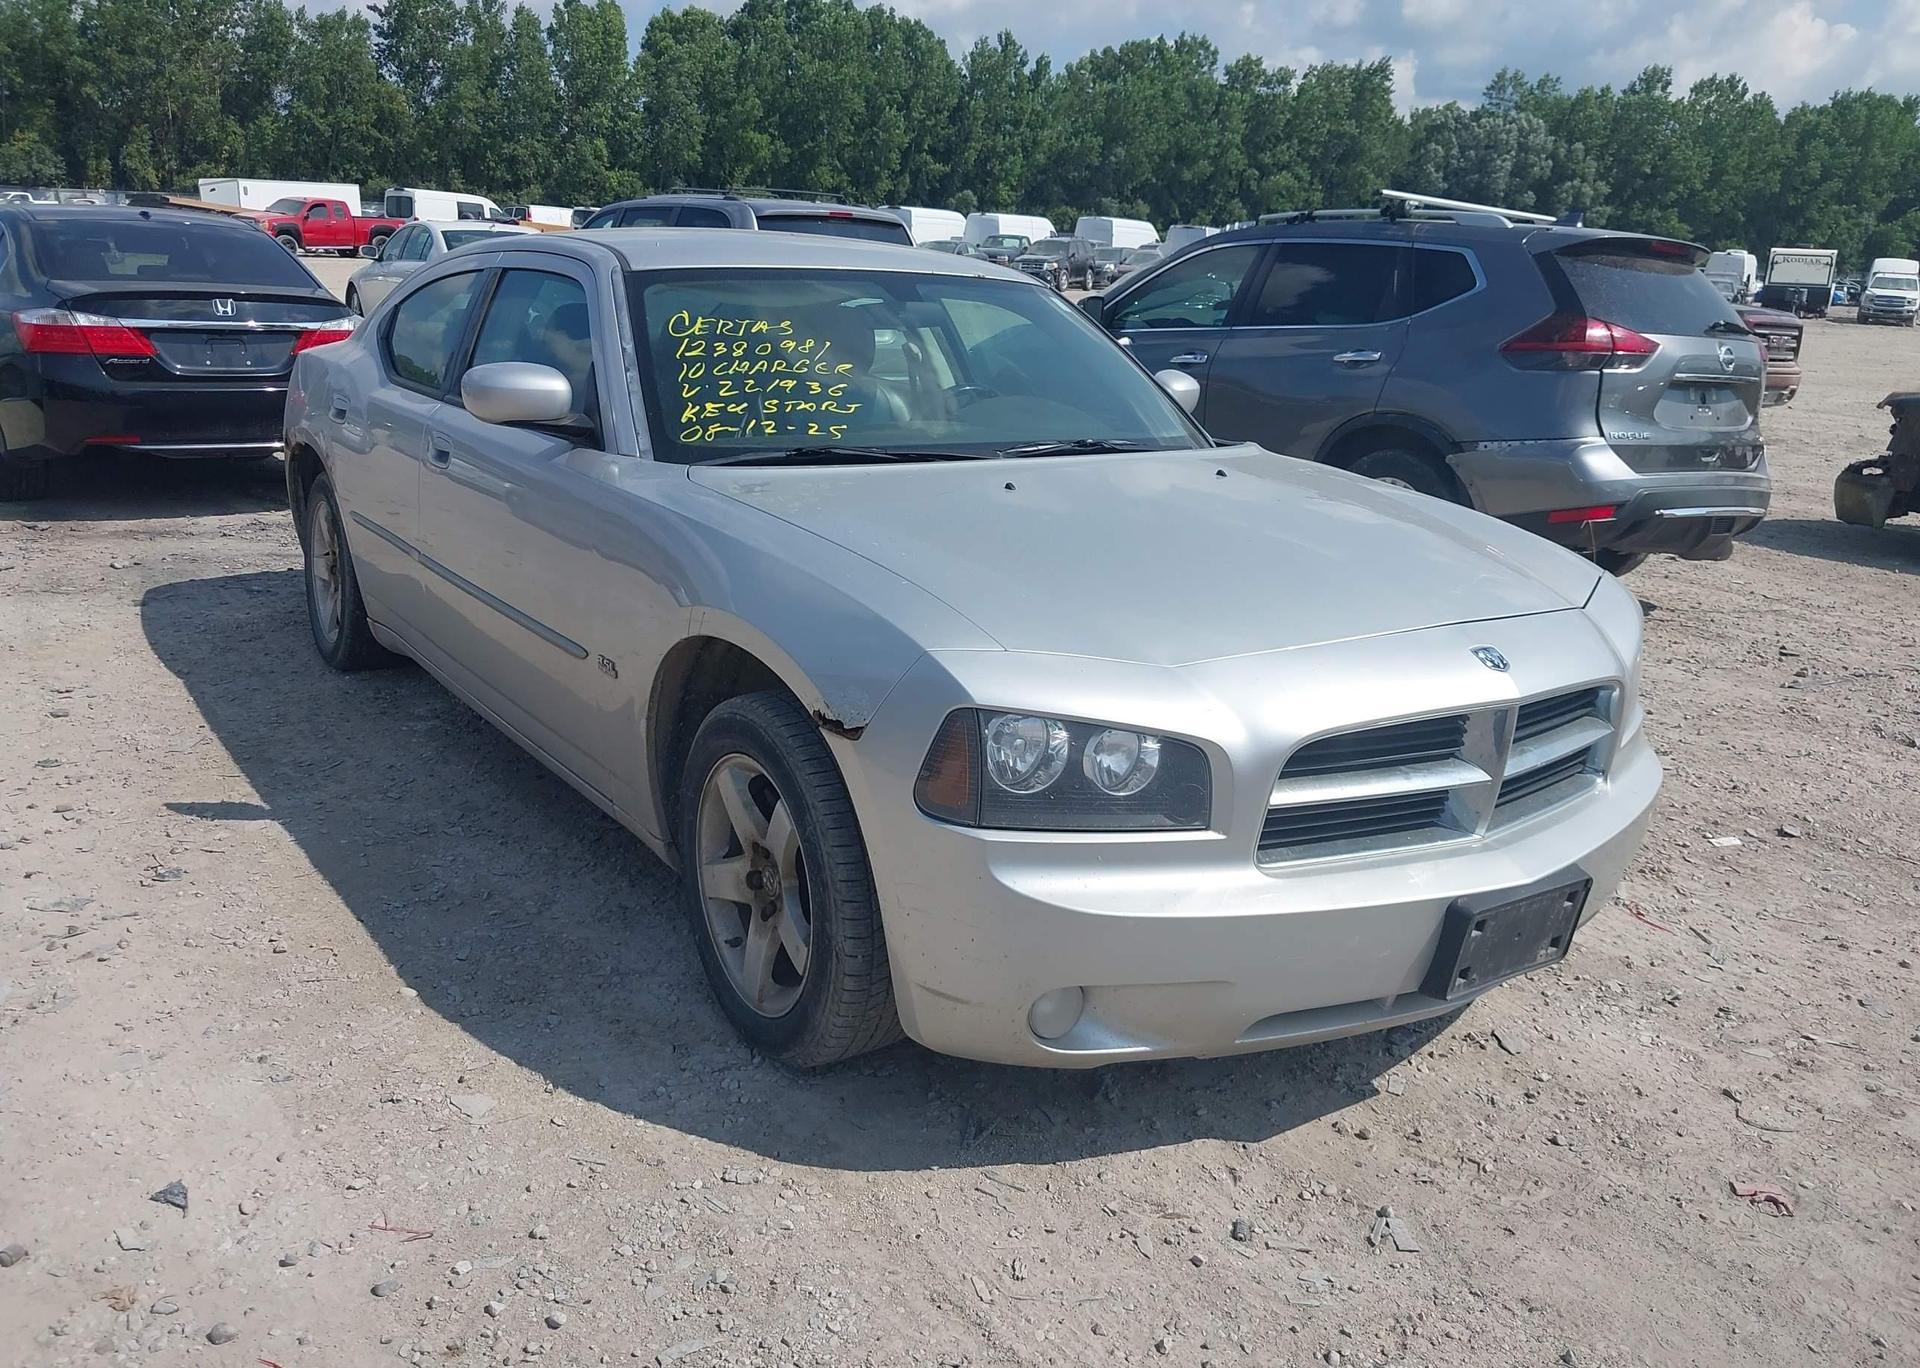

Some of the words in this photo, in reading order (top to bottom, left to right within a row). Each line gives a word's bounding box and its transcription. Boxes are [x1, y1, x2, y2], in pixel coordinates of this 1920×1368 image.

[1782, 256, 1823, 265] KODIAK
[678, 362, 706, 382] 10
[712, 359, 854, 378] CHARGER
[762, 400, 863, 414] START
[1609, 431, 1655, 440] ROGUE
